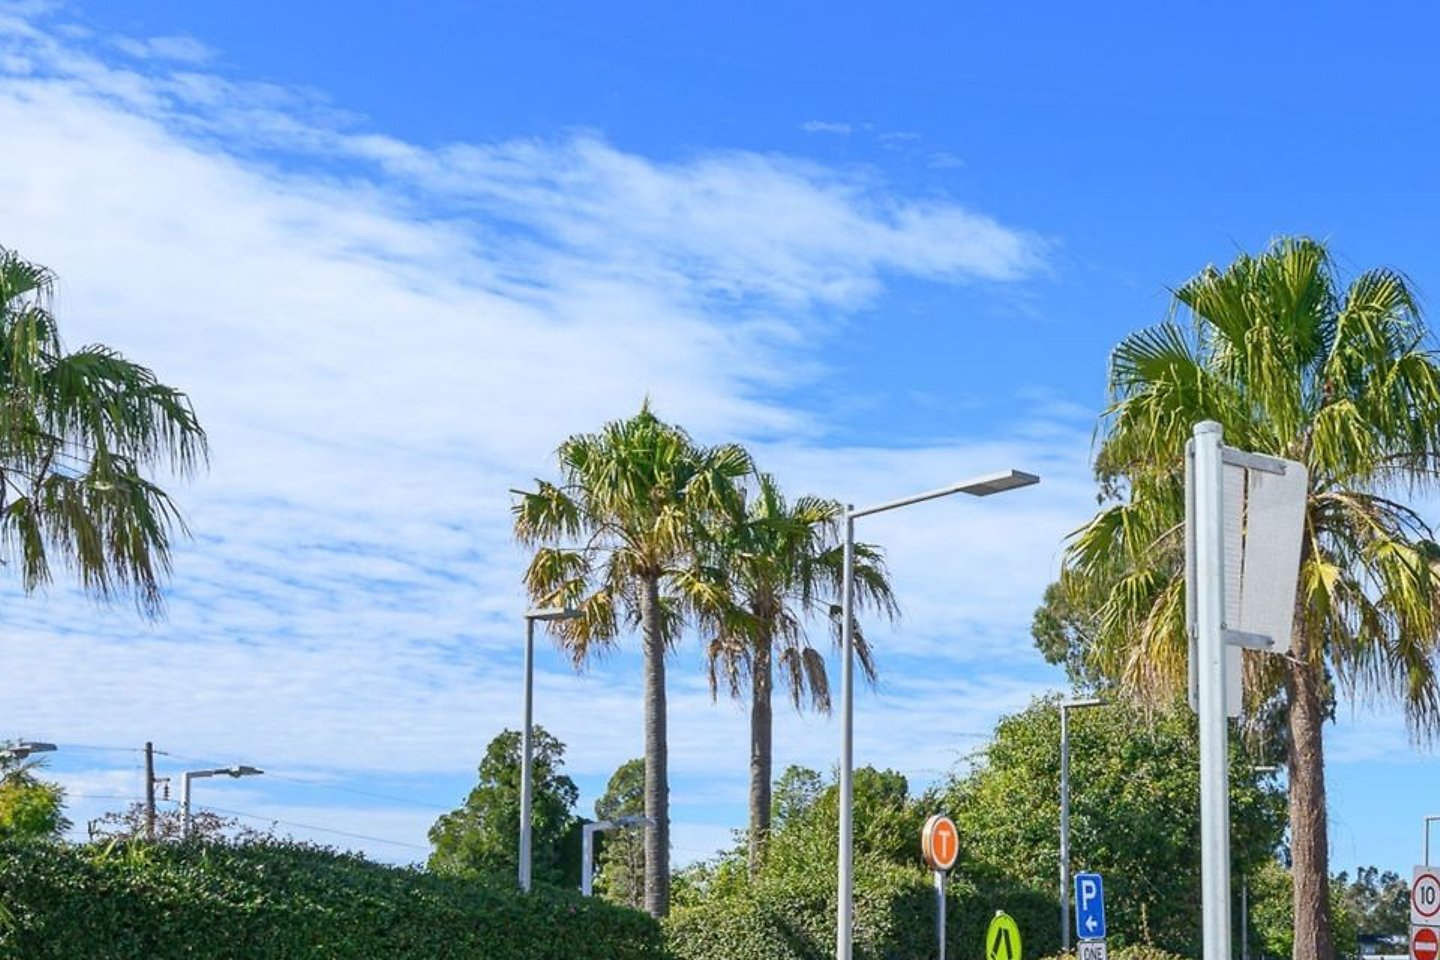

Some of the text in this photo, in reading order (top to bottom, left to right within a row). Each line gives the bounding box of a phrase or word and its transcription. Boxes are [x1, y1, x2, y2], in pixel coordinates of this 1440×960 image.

[938, 830, 951, 859] T
[1081, 880, 1096, 911] P
[1421, 886, 1436, 905] 10
[1083, 947, 1103, 960] ONE
